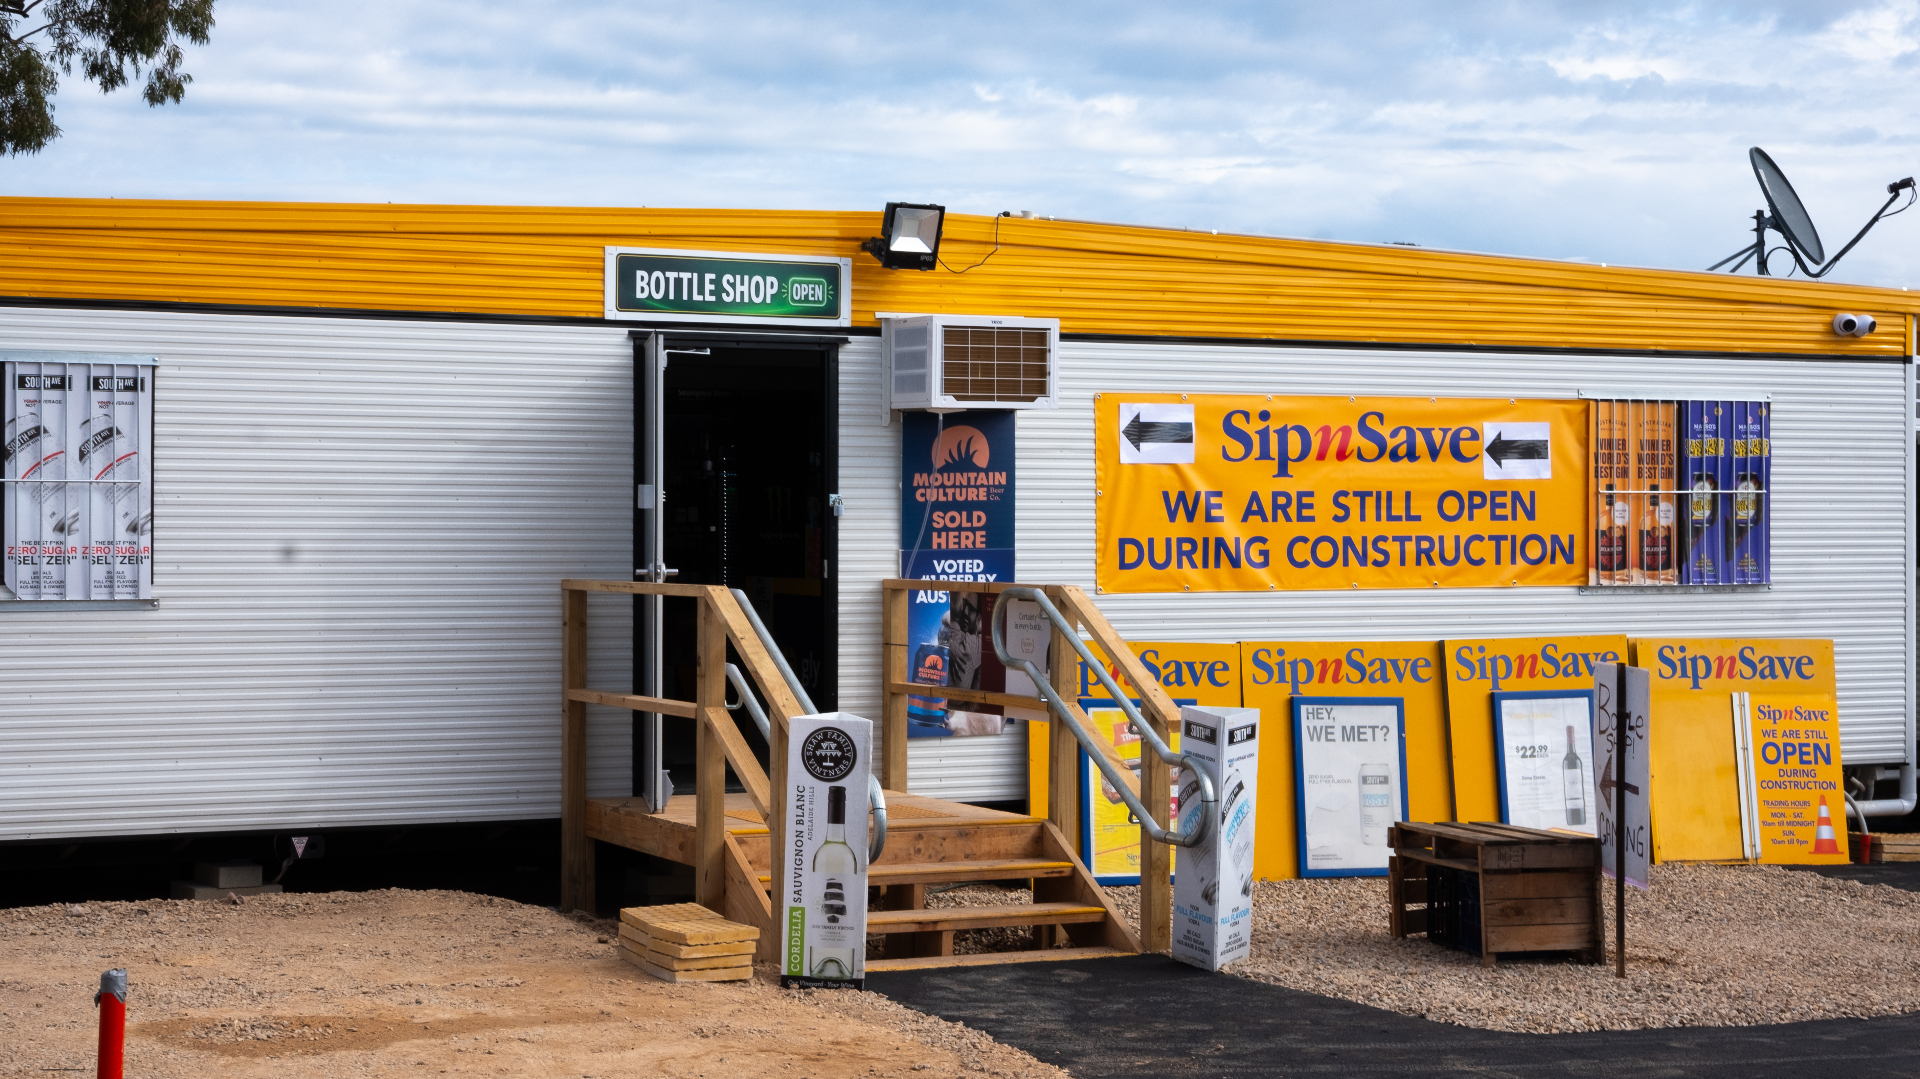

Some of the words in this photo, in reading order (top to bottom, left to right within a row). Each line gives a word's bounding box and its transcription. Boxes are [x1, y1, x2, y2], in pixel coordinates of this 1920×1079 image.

[636, 270, 716, 302] BOTTLE
[722, 274, 779, 304] SHOP
[792, 283, 823, 302] OPEN
[24, 376, 51, 388] SOUTH
[51, 377, 62, 385] AVE
[98, 378, 124, 390] SOUTH
[124, 379, 134, 387] AVE
[1220, 408, 1480, 478] SipnSave
[912, 472, 1007, 486] MOUNTAIN
[1594, 466, 1614, 478] BEST
[1616, 466, 1630, 478] GIN
[1638, 467, 1658, 479] BEST
[1660, 467, 1674, 480] GIN
[915, 487, 988, 502] CULTURE
[1161, 490, 1224, 524] WE
[1240, 490, 1316, 524] ARE
[1332, 490, 1422, 523] STILL
[1437, 490, 1536, 522] OPEN
[932, 511, 986, 528] SOLD
[932, 531, 986, 550] HERE
[8, 546, 38, 554] ZERO
[42, 546, 78, 554] SUGAR
[82, 546, 111, 554] ZERO
[116, 546, 150, 554] SUGAR
[1118, 536, 1270, 570] DURING
[1286, 534, 1575, 569] CONSTRUCTION
[932, 559, 984, 574] VOTED
[918, 672, 940, 680] CULTURE
[1252, 648, 1432, 696] SipnSave
[1658, 645, 1815, 690] SipnSave
[1306, 707, 1336, 722] HEY,
[1757, 704, 1830, 724] SipnSave
[1306, 725, 1336, 742] WE
[1341, 725, 1390, 742] MET?
[1761, 729, 1778, 738] WE
[1782, 730, 1801, 739] ARE
[1804, 730, 1828, 740] STILL
[806, 732, 824, 756] SHAW
[828, 732, 852, 758] FAMILY
[1516, 744, 1548, 758] $22.99
[1762, 742, 1832, 766] OPEN
[808, 758, 849, 776] VINTNERS
[1778, 768, 1817, 778] DURING
[1760, 780, 1836, 790] CONSTRUCTION
[796, 785, 806, 826] BLANC
[1600, 812, 1644, 859] GAMNG
[793, 830, 804, 904] SAUVIGNON
[1176, 905, 1188, 916] FULL
[1190, 910, 1212, 925] FLAVOUR
[1188, 918, 1200, 926] VODKA
[1220, 916, 1230, 925] FULL
[1230, 908, 1250, 922] FLAVOUR
[790, 910, 802, 972] CORDELIA
[1198, 946, 1210, 956] OWNED
[800, 980, 824, 988] Vineyard
